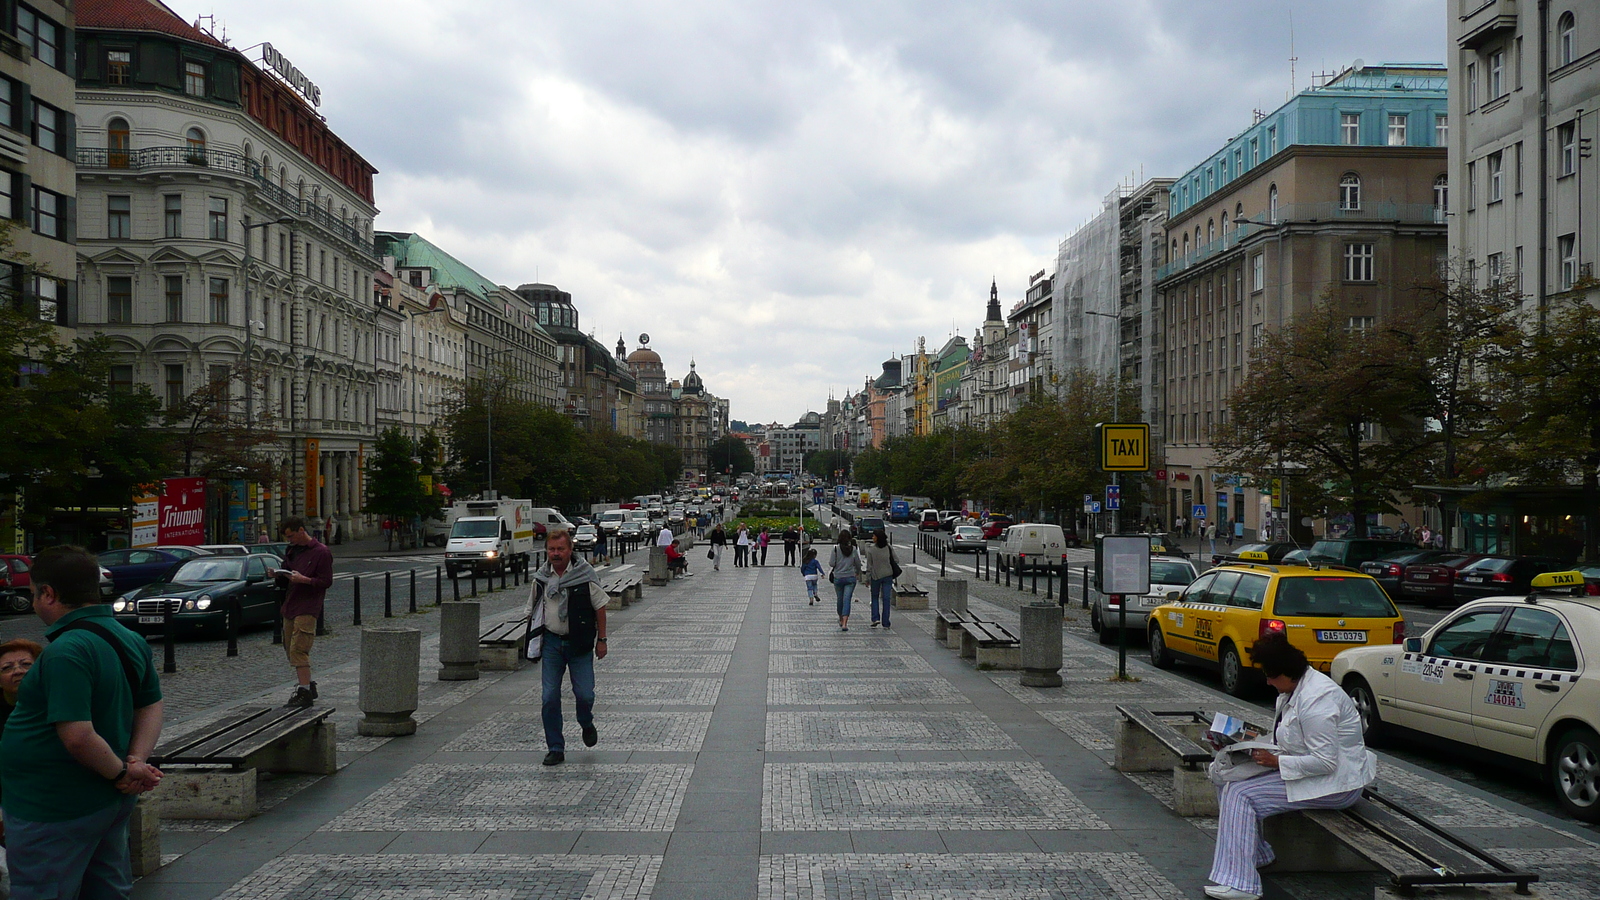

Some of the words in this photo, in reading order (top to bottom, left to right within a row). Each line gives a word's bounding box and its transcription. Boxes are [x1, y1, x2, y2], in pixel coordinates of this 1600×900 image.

[263, 42, 321, 107] OLYMPUS
[938, 370, 960, 385] MERAN
[1111, 439, 1139, 456] TAXI
[161, 505, 203, 528] Triumph
[164, 528, 201, 539] INTERNATIONAL
[1552, 574, 1574, 584] TAXI
[1323, 632, 1338, 640] 6A5
[1343, 632, 1363, 641] 0379
[1383, 657, 1394, 665] 670
[1422, 663, 1444, 679] 220-456
[1493, 694, 1516, 706] 14014
